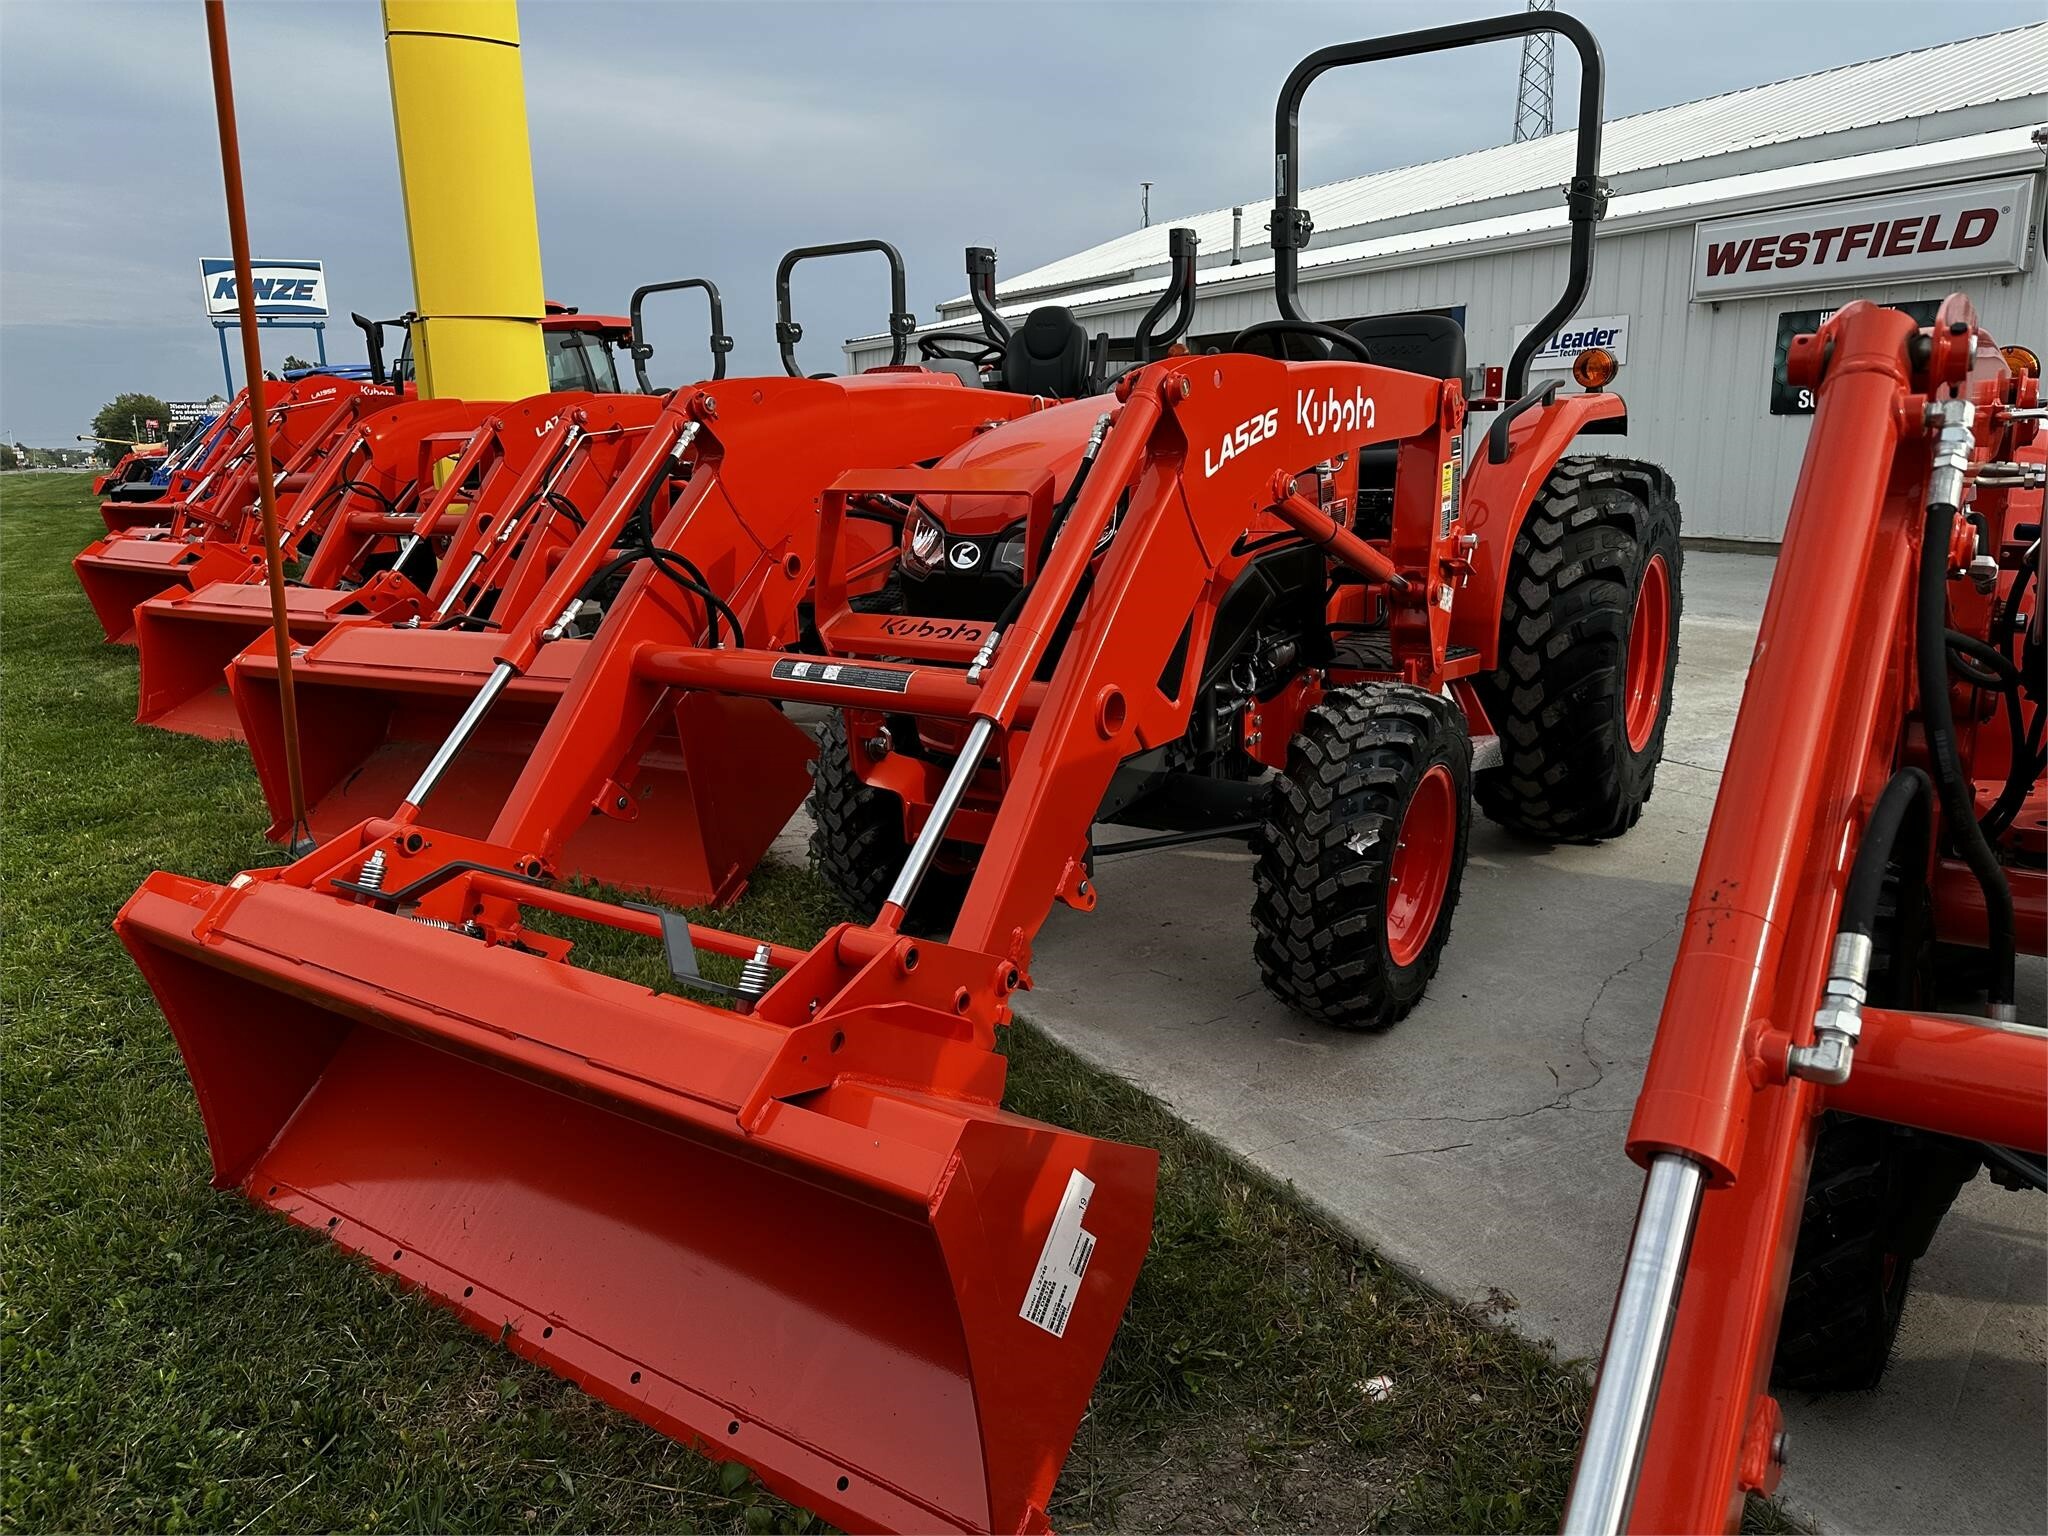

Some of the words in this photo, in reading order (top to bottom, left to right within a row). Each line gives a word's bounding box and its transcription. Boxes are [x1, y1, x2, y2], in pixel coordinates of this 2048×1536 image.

[212, 277, 318, 301] KNZE
[1296, 385, 1375, 436] Kubota
[535, 415, 559, 437] LA7
[1204, 407, 1279, 479] LA526
[880, 618, 982, 642] Kubota
